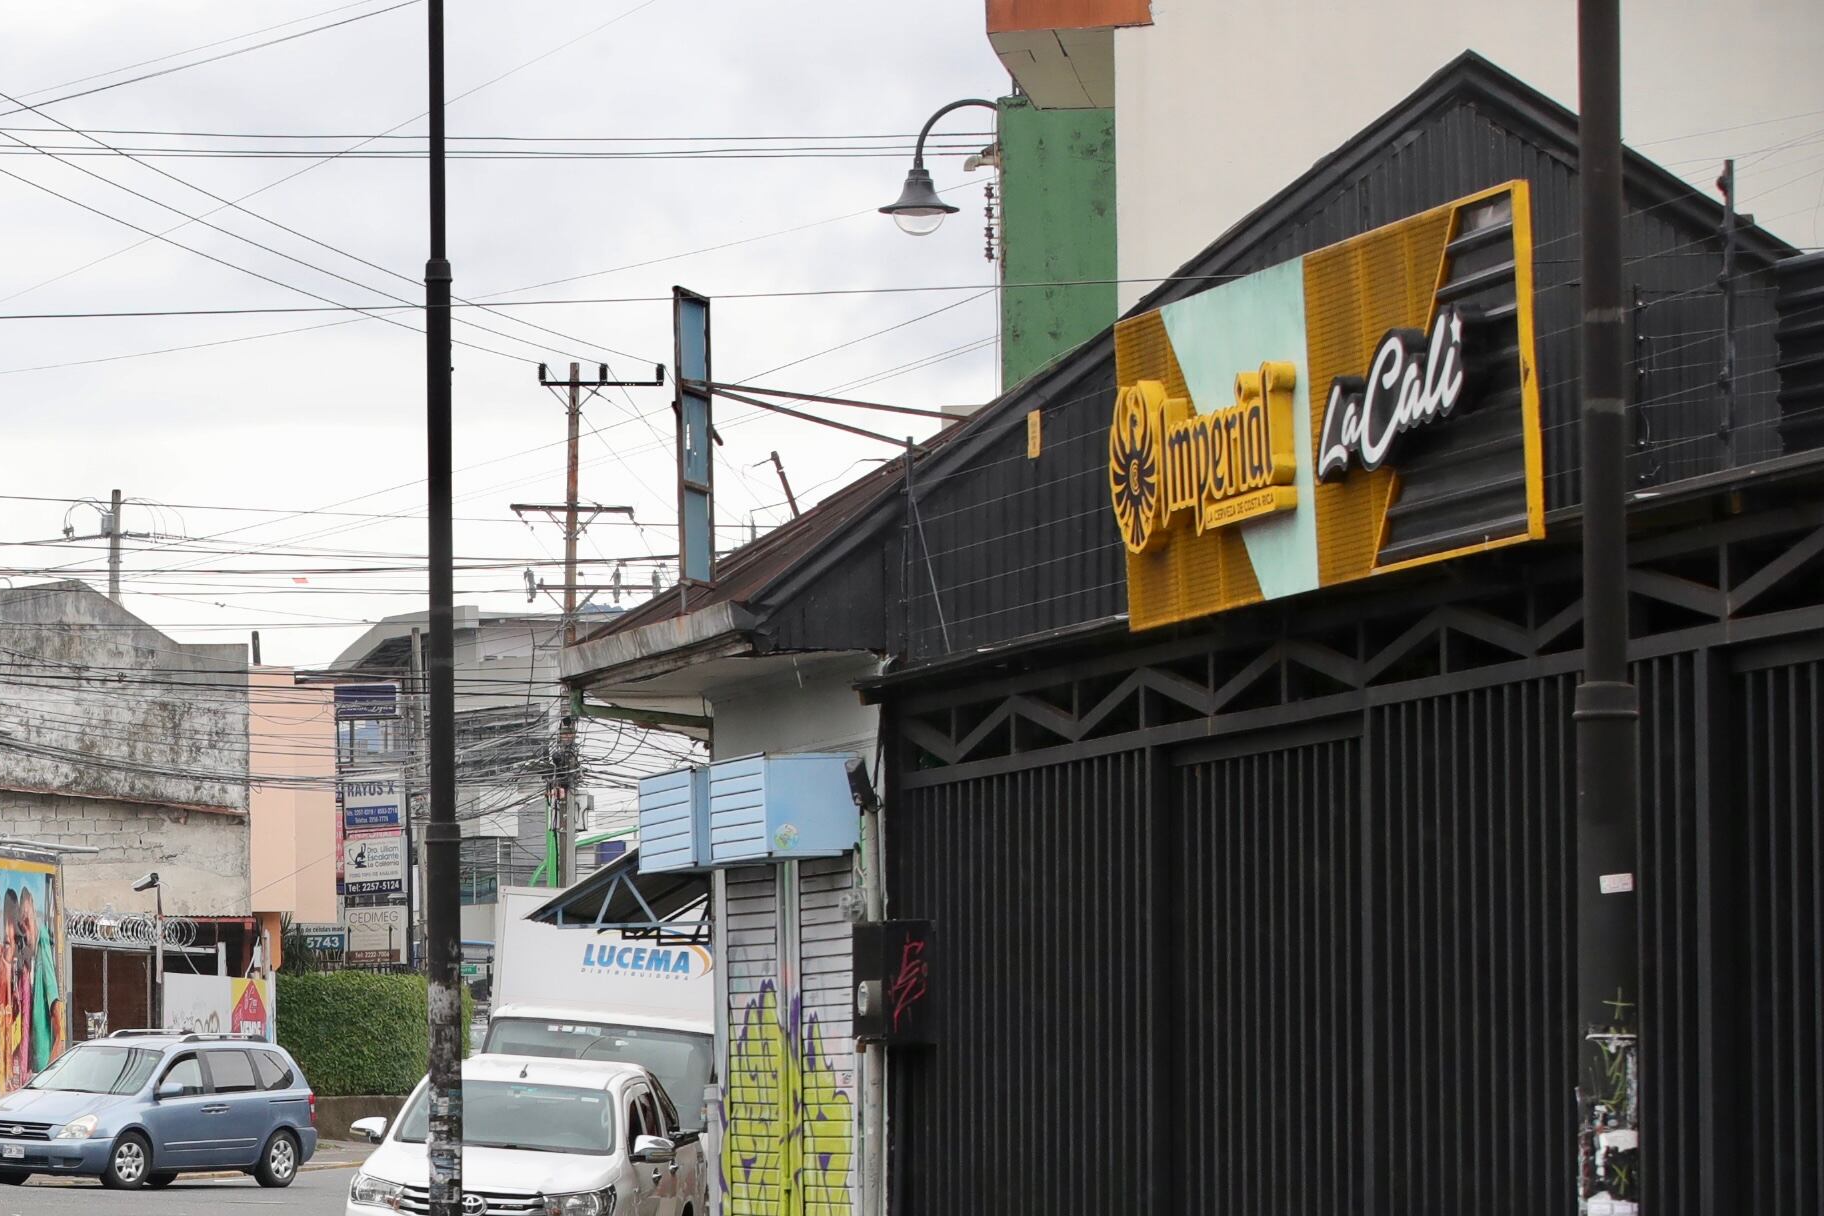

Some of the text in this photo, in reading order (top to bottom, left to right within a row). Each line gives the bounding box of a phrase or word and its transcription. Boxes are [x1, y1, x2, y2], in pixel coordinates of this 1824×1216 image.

[1361, 312, 1463, 464] Cali
[1160, 362, 1275, 535] Imperial
[348, 880, 400, 893] Tel: 2257-5124
[349, 910, 399, 924] CEDIMEG
[582, 943, 690, 974] LUCEMA
